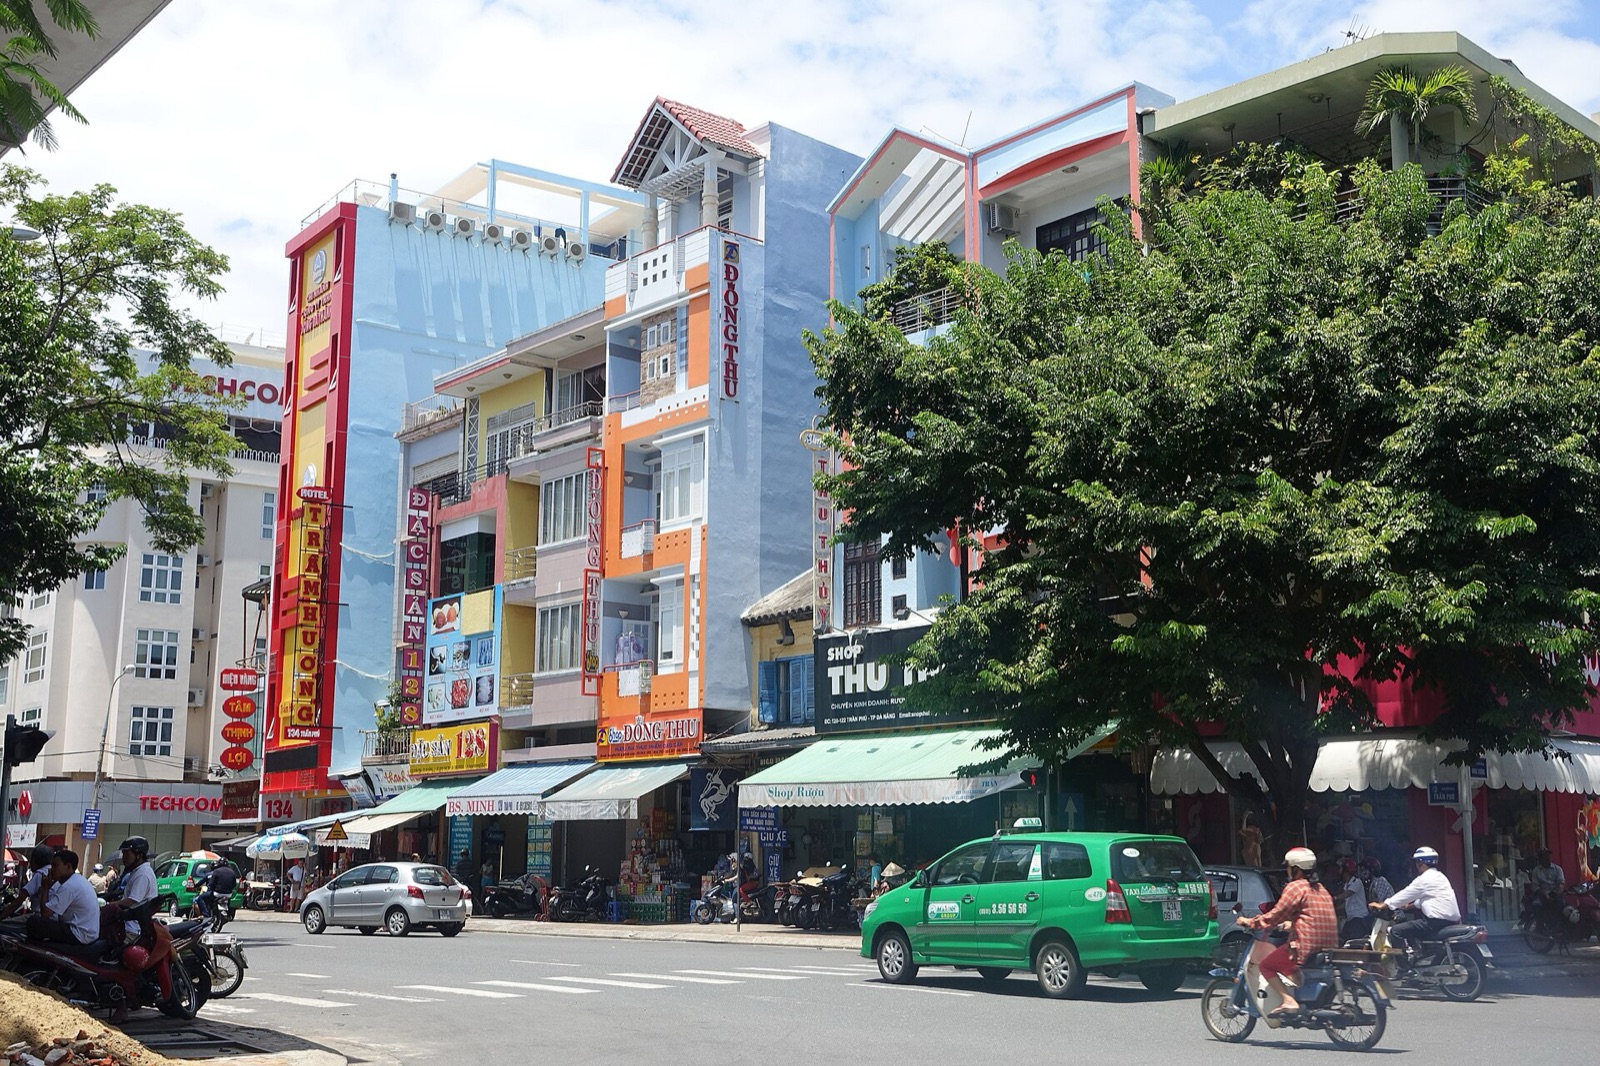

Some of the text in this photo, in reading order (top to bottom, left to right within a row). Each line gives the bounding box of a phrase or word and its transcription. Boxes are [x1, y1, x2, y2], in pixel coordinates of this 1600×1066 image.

[724, 343, 738, 398] THU
[300, 489, 329, 501] HOTEL
[817, 459, 828, 521] TU
[406, 571, 424, 640] SẢN
[827, 644, 863, 662] SHOP
[403, 651, 420, 722] 128
[827, 662, 888, 695] THU
[229, 700, 250, 713] TÂM
[225, 727, 253, 740] THỊNH
[287, 728, 301, 738] 134
[666, 719, 697, 740] THU
[455, 728, 486, 759] 128
[228, 752, 247, 766] LỢI
[767, 786, 794, 800] Shop
[266, 799, 293, 818] 134
[449, 801, 464, 812] BS.
[467, 799, 495, 812] MINH
[776, 830, 787, 841] XE
[1124, 888, 1140, 896] TAXI
